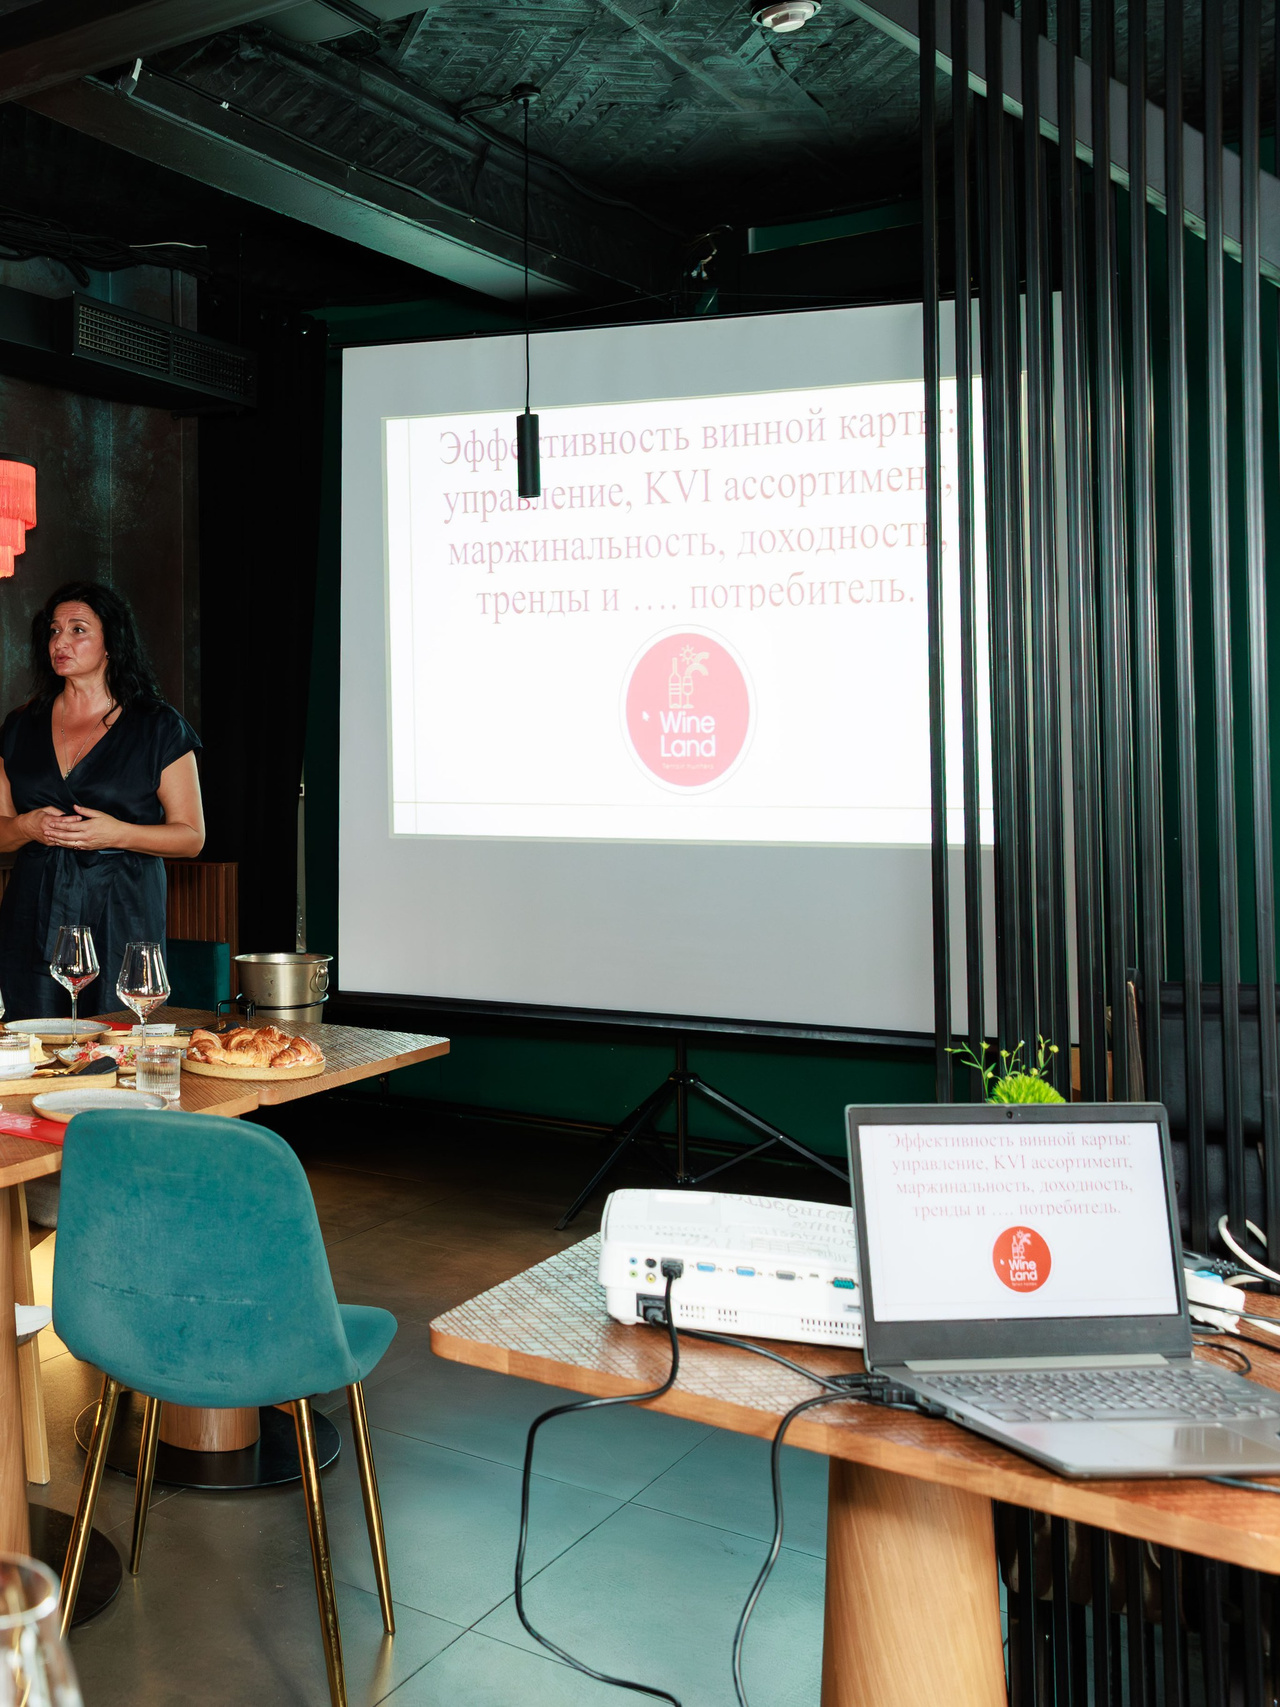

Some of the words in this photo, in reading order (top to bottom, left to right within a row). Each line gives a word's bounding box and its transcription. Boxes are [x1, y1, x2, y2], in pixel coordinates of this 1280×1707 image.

[440, 426, 690, 473] Эффетивность
[701, 407, 826, 450] винной
[644, 466, 712, 505] KVI
[724, 464, 953, 508] ассортимен,
[449, 532, 726, 574] маржинальность,
[476, 588, 590, 625] тренды
[601, 588, 620, 612] и
[689, 571, 915, 612] потребитель.
[660, 710, 716, 734] Wine
[661, 734, 716, 758] Land
[888, 1132, 1014, 1152] Эффективность
[1020, 1131, 1076, 1147] винной
[1081, 1133, 1132, 1150] карты:
[891, 1158, 989, 1175] управление,
[993, 1154, 1026, 1170] KVI
[1031, 1156, 1133, 1173] ассортимент,
[896, 1181, 1035, 1198] маржинальность,
[1039, 1179, 1133, 1194] доходность,
[913, 1203, 971, 1220] тренды
[976, 1203, 986, 1216] и
[1019, 1198, 1121, 1217] потребитель.
[1008, 1258, 1037, 1271] Wine
[1010, 1269, 1038, 1281] Land
